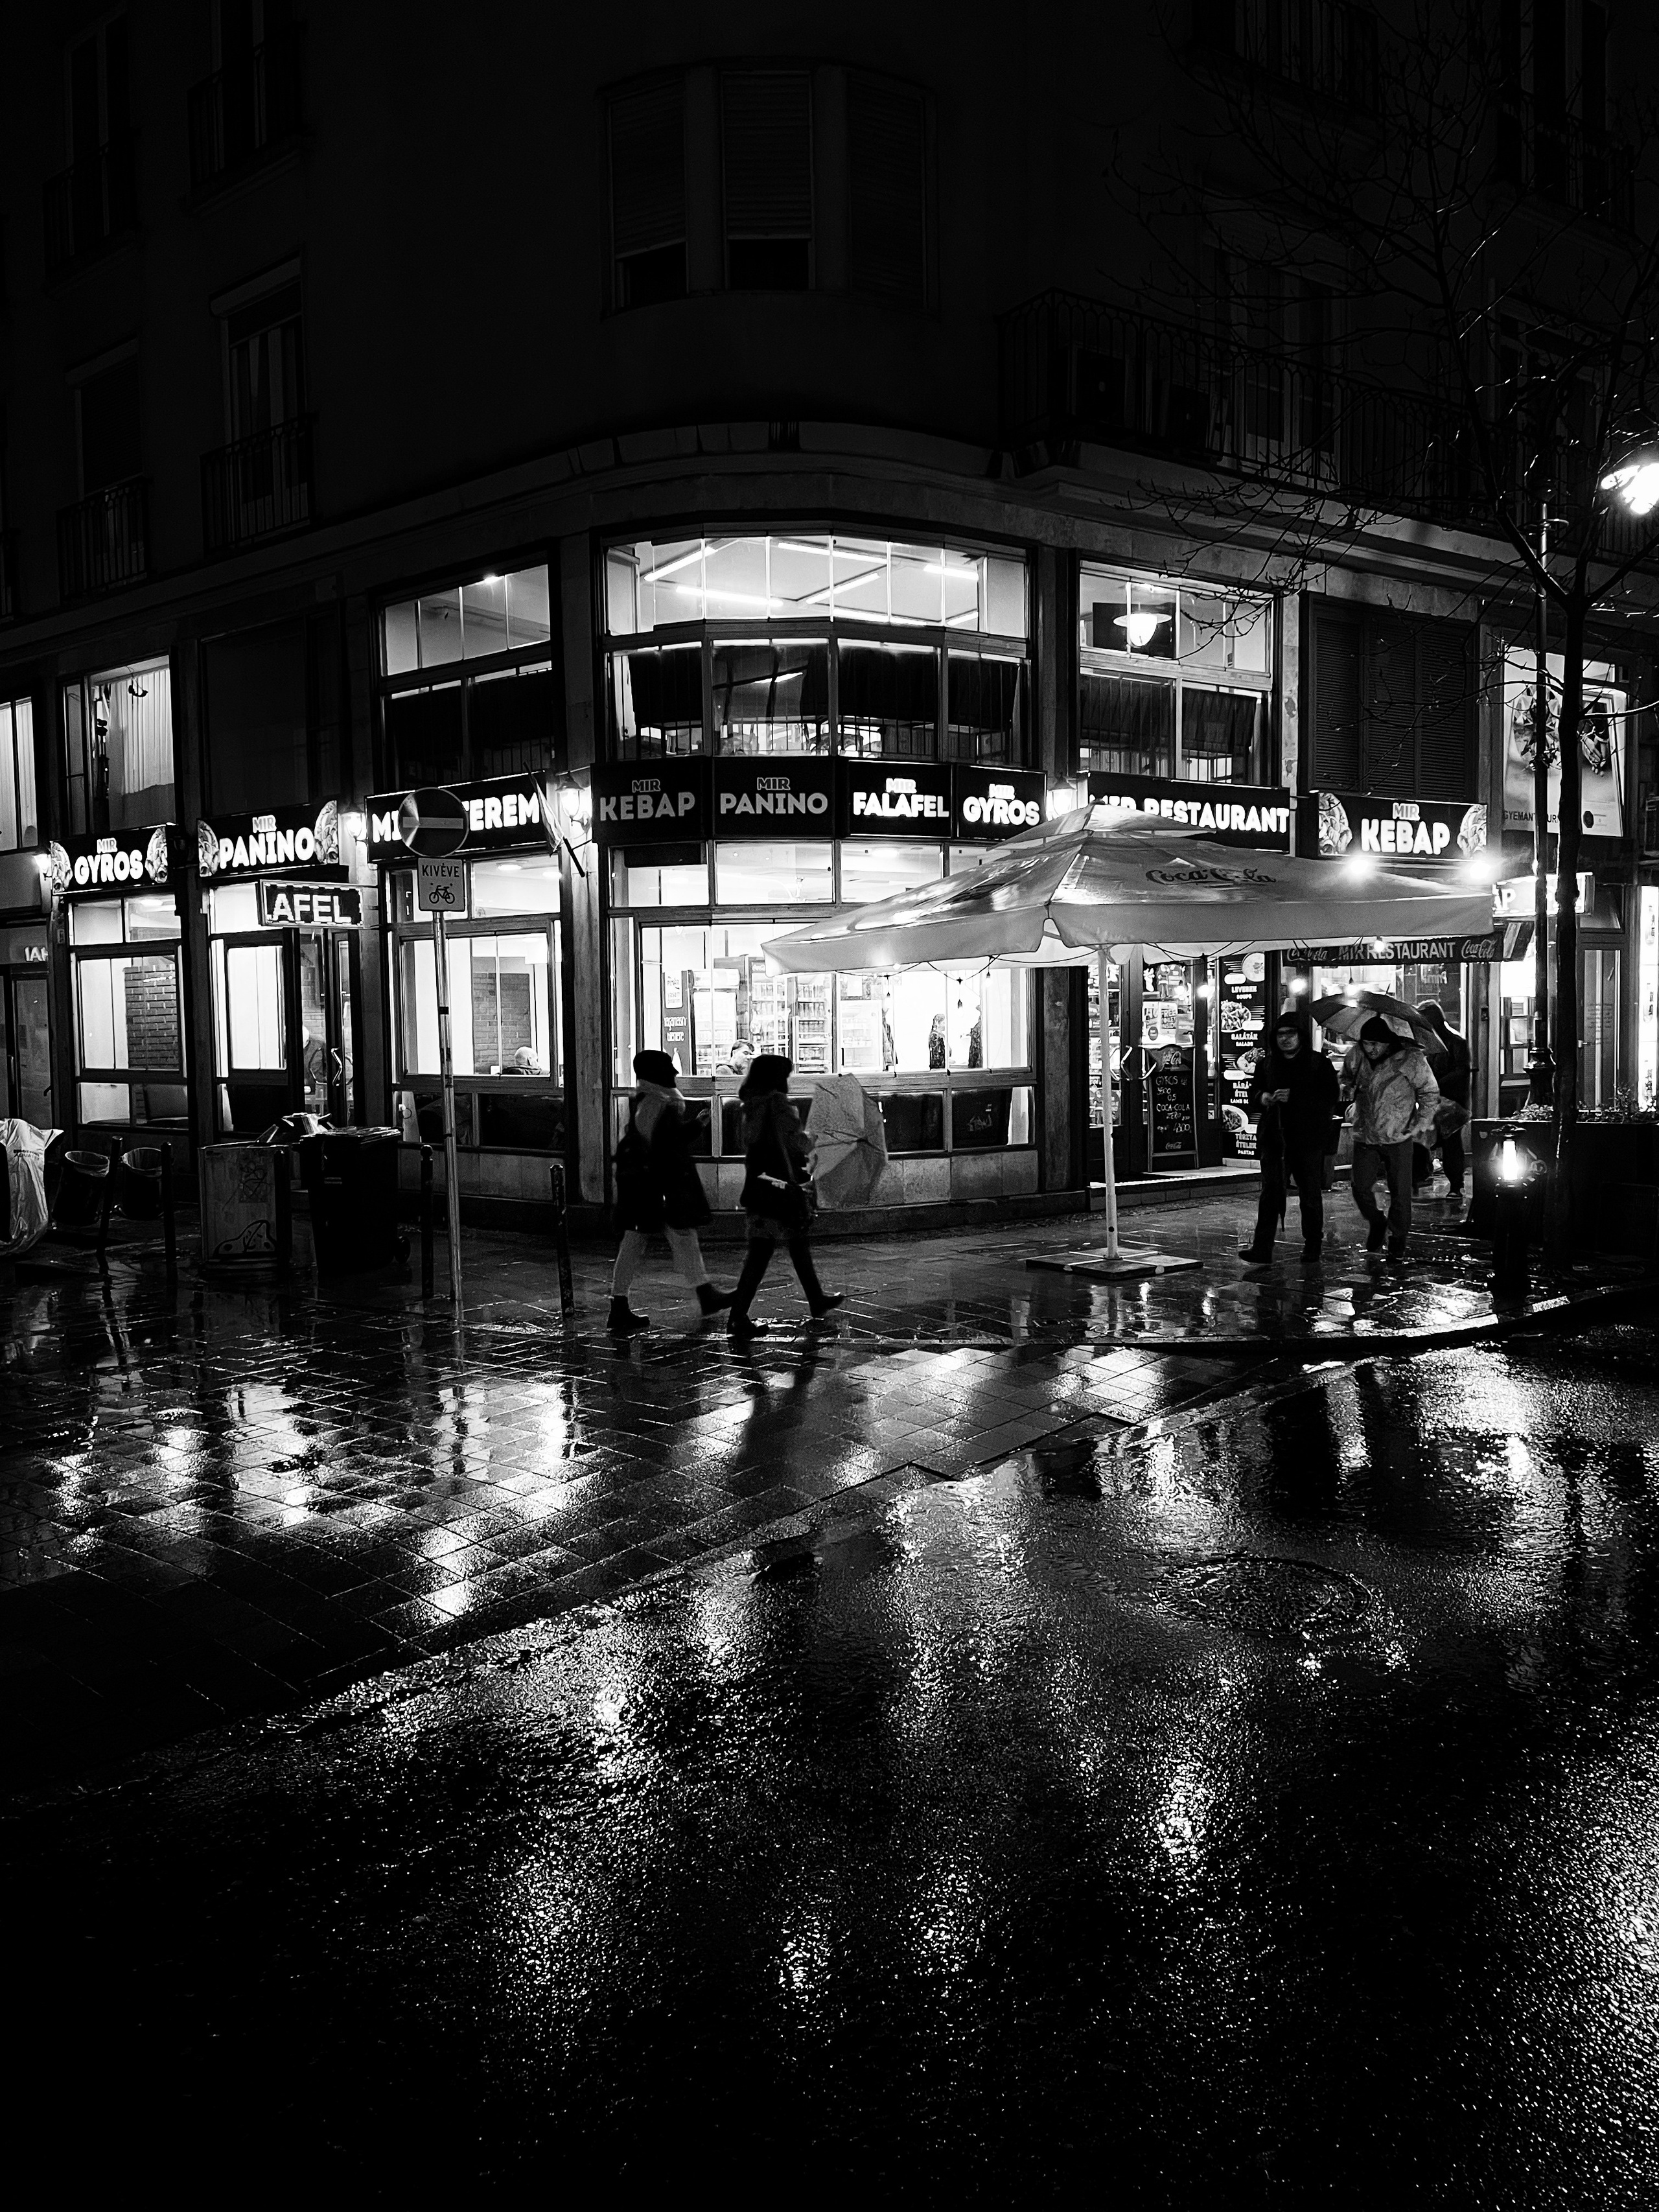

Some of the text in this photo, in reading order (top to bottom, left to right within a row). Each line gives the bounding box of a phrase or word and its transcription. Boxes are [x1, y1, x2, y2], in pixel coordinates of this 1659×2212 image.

[632, 779, 660, 793] MIR
[756, 778, 790, 791] MIR
[886, 778, 916, 793] MIR
[989, 784, 1015, 800] MIR
[600, 791, 695, 821] KEBAP
[721, 793, 828, 815] PANINO
[853, 792, 949, 817] FALAFEL
[963, 797, 1039, 825] GYROS
[1144, 797, 1289, 833] RESTAURANT
[1392, 803, 1420, 821] MIR
[252, 815, 277, 833] MIR
[372, 793, 540, 843] MI EREM
[1503, 809, 1535, 822] GYEMAN
[97, 838, 117, 854] MIR
[219, 827, 316, 869] PANINO
[1361, 819, 1451, 855] KEBAP
[74, 850, 144, 885] GYROS
[422, 862, 459, 878] KIVÉVE
[272, 893, 353, 924] AFEL
